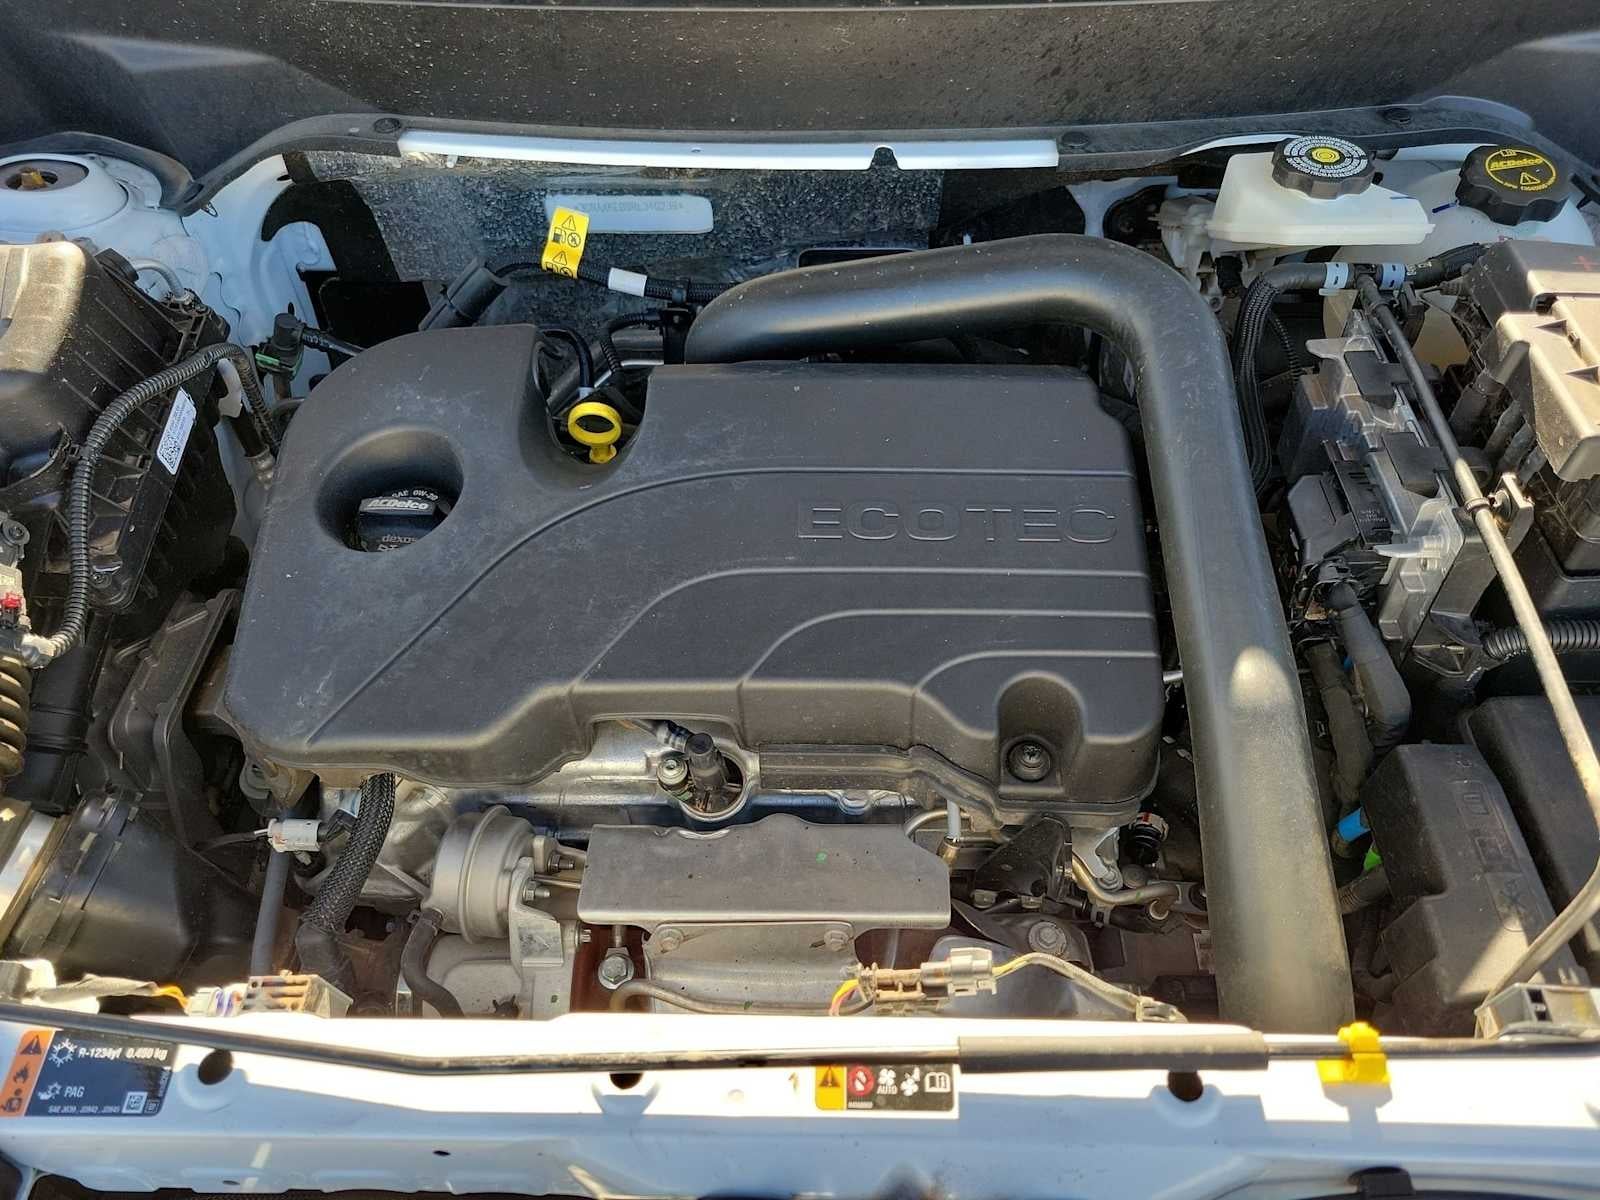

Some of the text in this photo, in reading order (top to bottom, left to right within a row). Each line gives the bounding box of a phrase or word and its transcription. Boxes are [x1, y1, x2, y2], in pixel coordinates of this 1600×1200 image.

[367, 498, 430, 510] ACDelco
[797, 504, 1119, 544] ECOTEC
[153, 1047, 168, 1061] kg
[63, 1086, 86, 1098] PAG
[876, 1085, 898, 1095] AUTO
